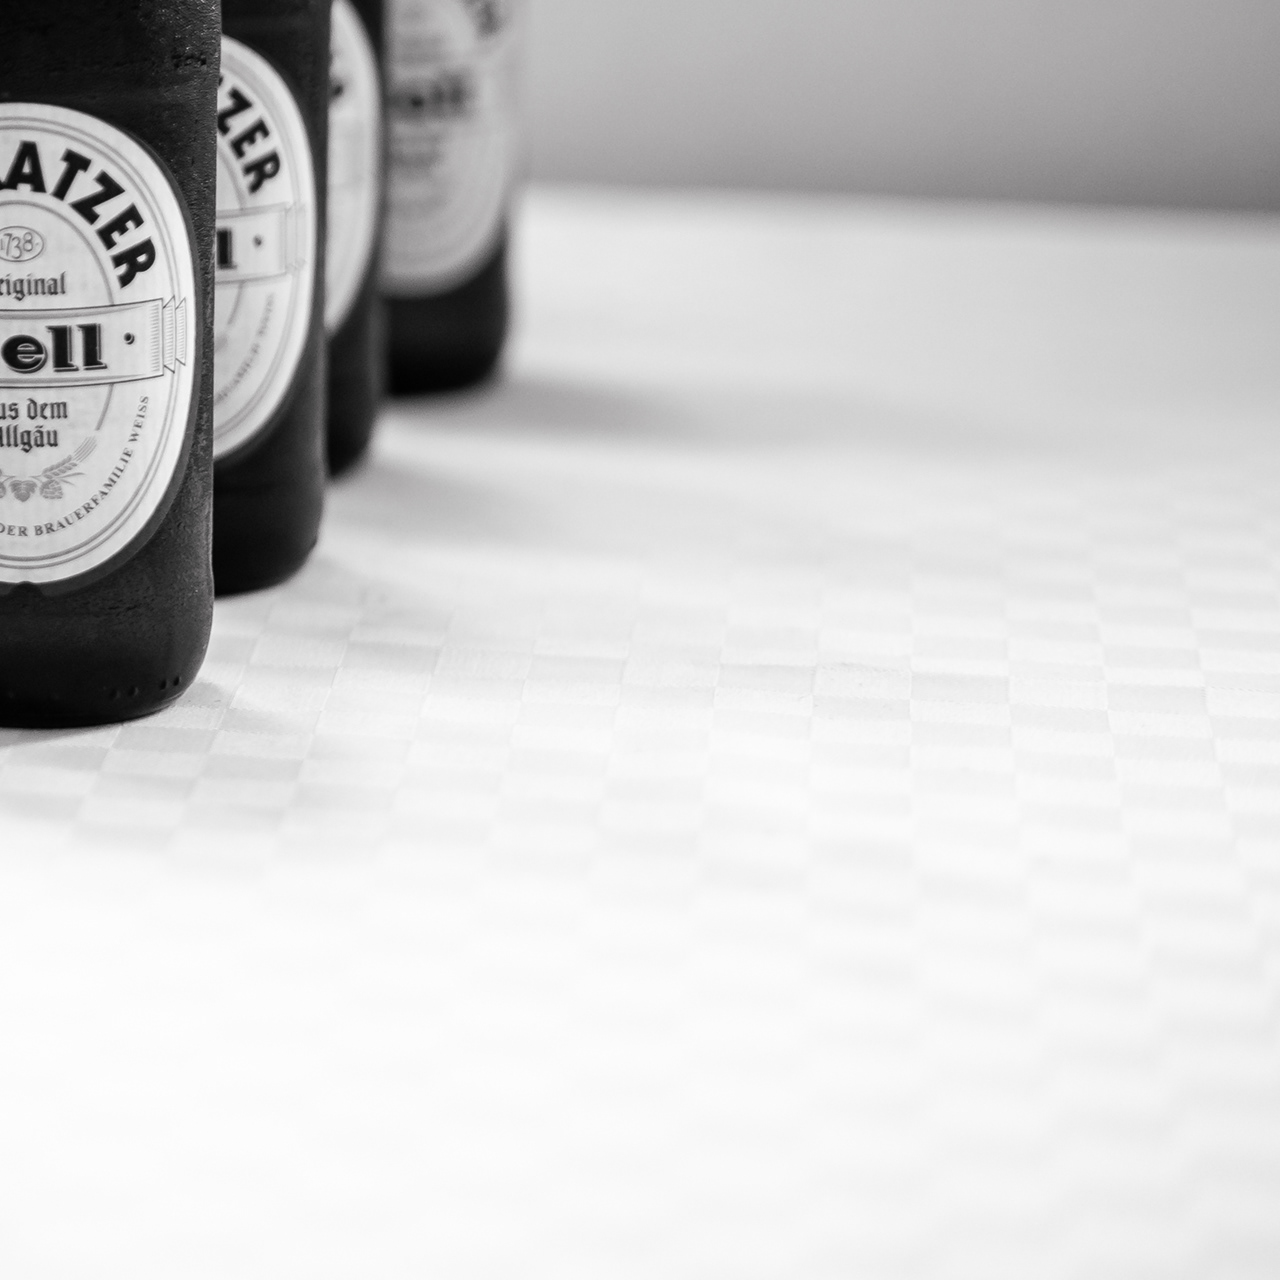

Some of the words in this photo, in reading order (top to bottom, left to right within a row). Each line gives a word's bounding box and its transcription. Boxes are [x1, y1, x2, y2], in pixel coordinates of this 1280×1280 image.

[27, 398, 69, 420] dem
[34, 447, 134, 536] BRAUERFAMILIE
[129, 395, 149, 444] WEISS
